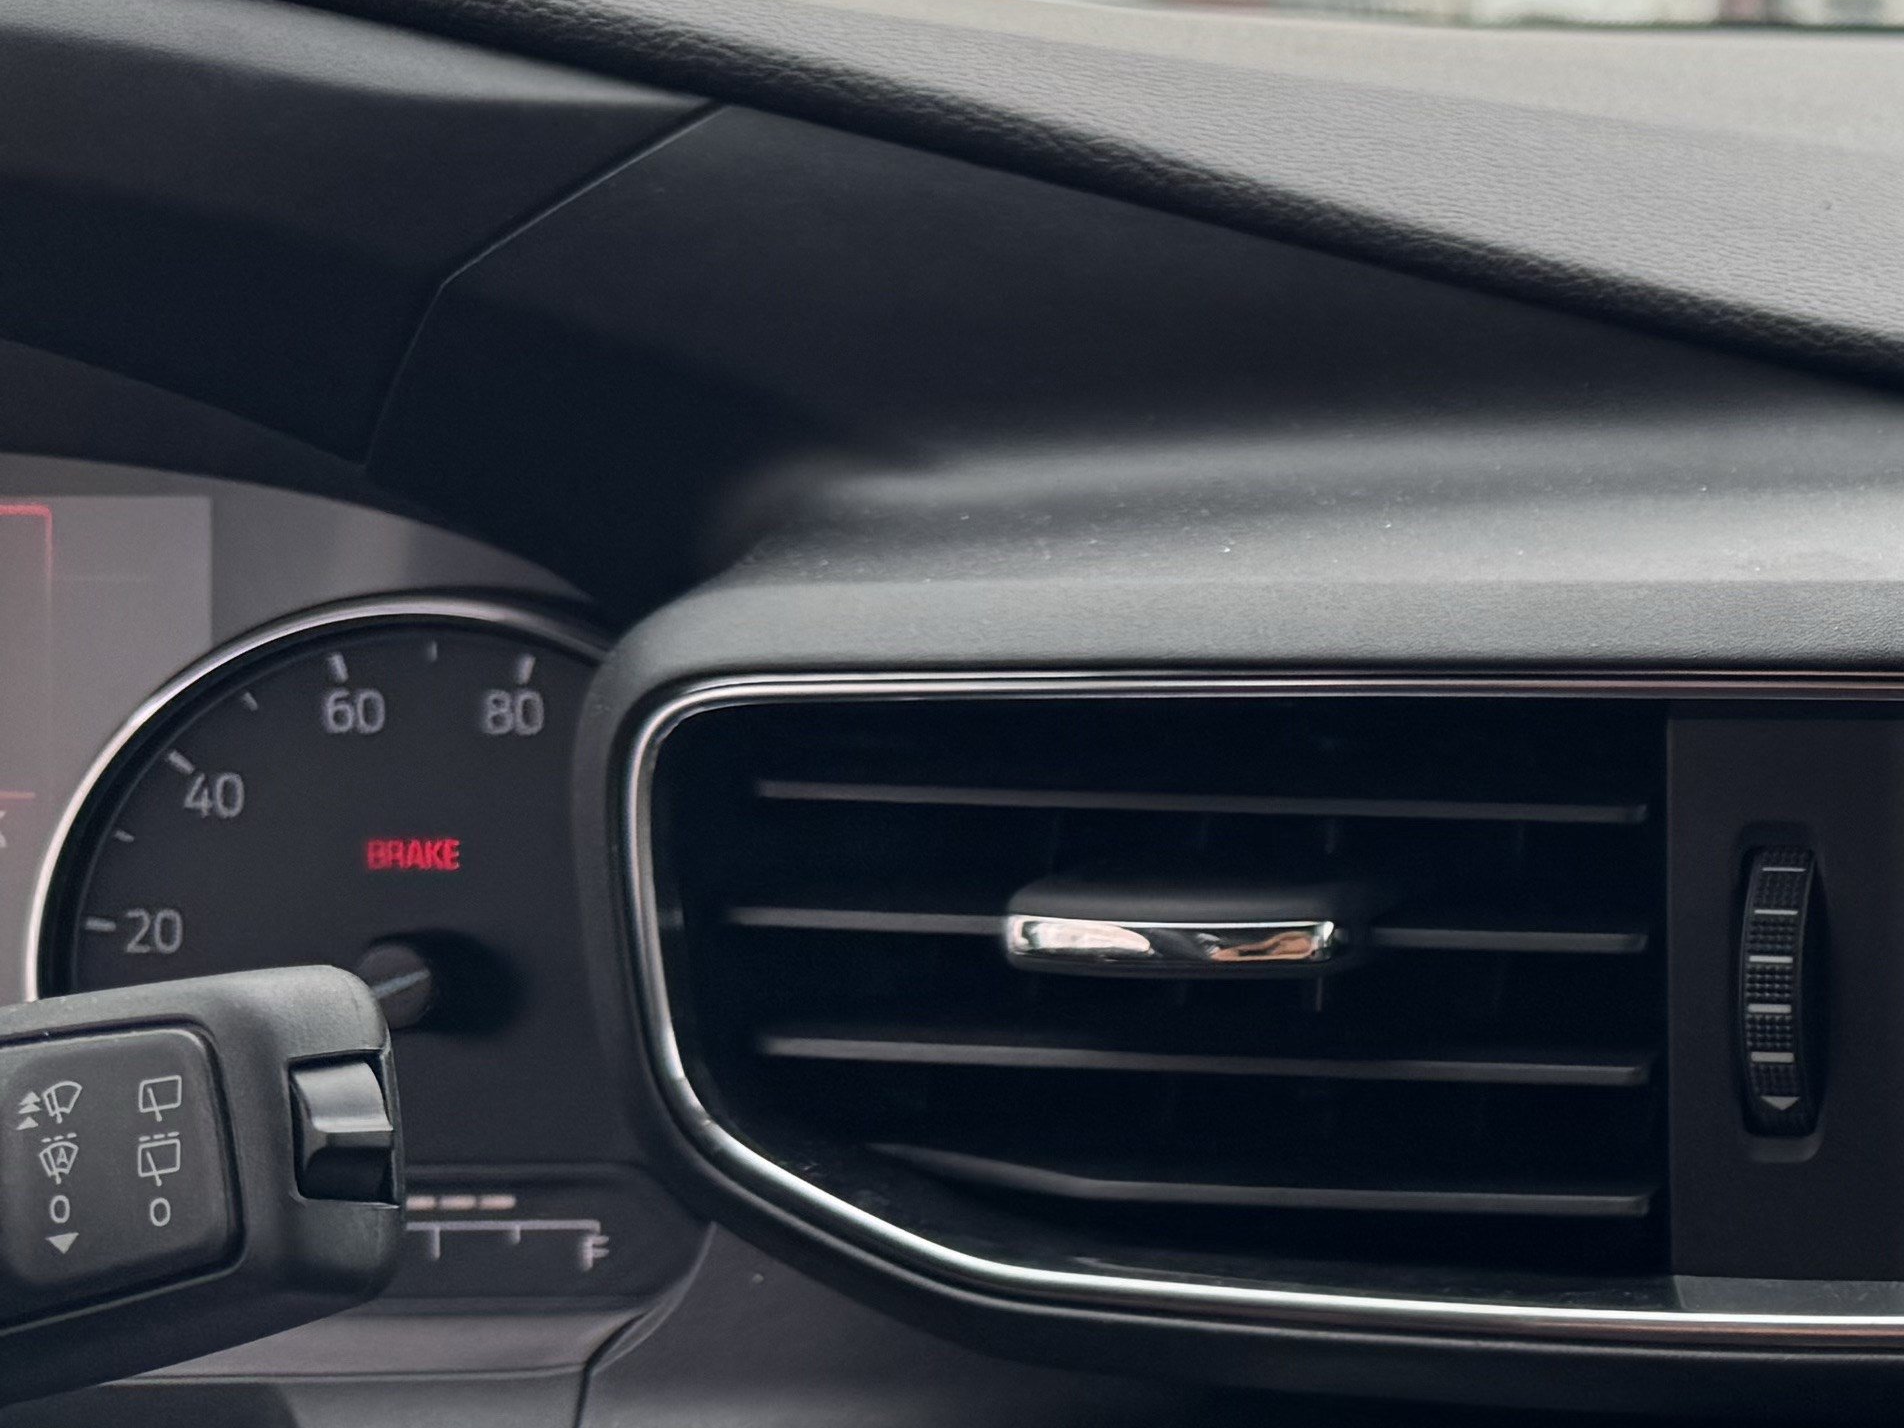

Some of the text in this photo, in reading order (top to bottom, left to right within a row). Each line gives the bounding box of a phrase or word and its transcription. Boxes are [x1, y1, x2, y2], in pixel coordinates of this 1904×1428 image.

[325, 690, 384, 733] 60
[485, 691, 542, 734] 80
[184, 771, 245, 819] 40
[366, 837, 461, 871] BRAKE
[126, 909, 183, 953] 20
